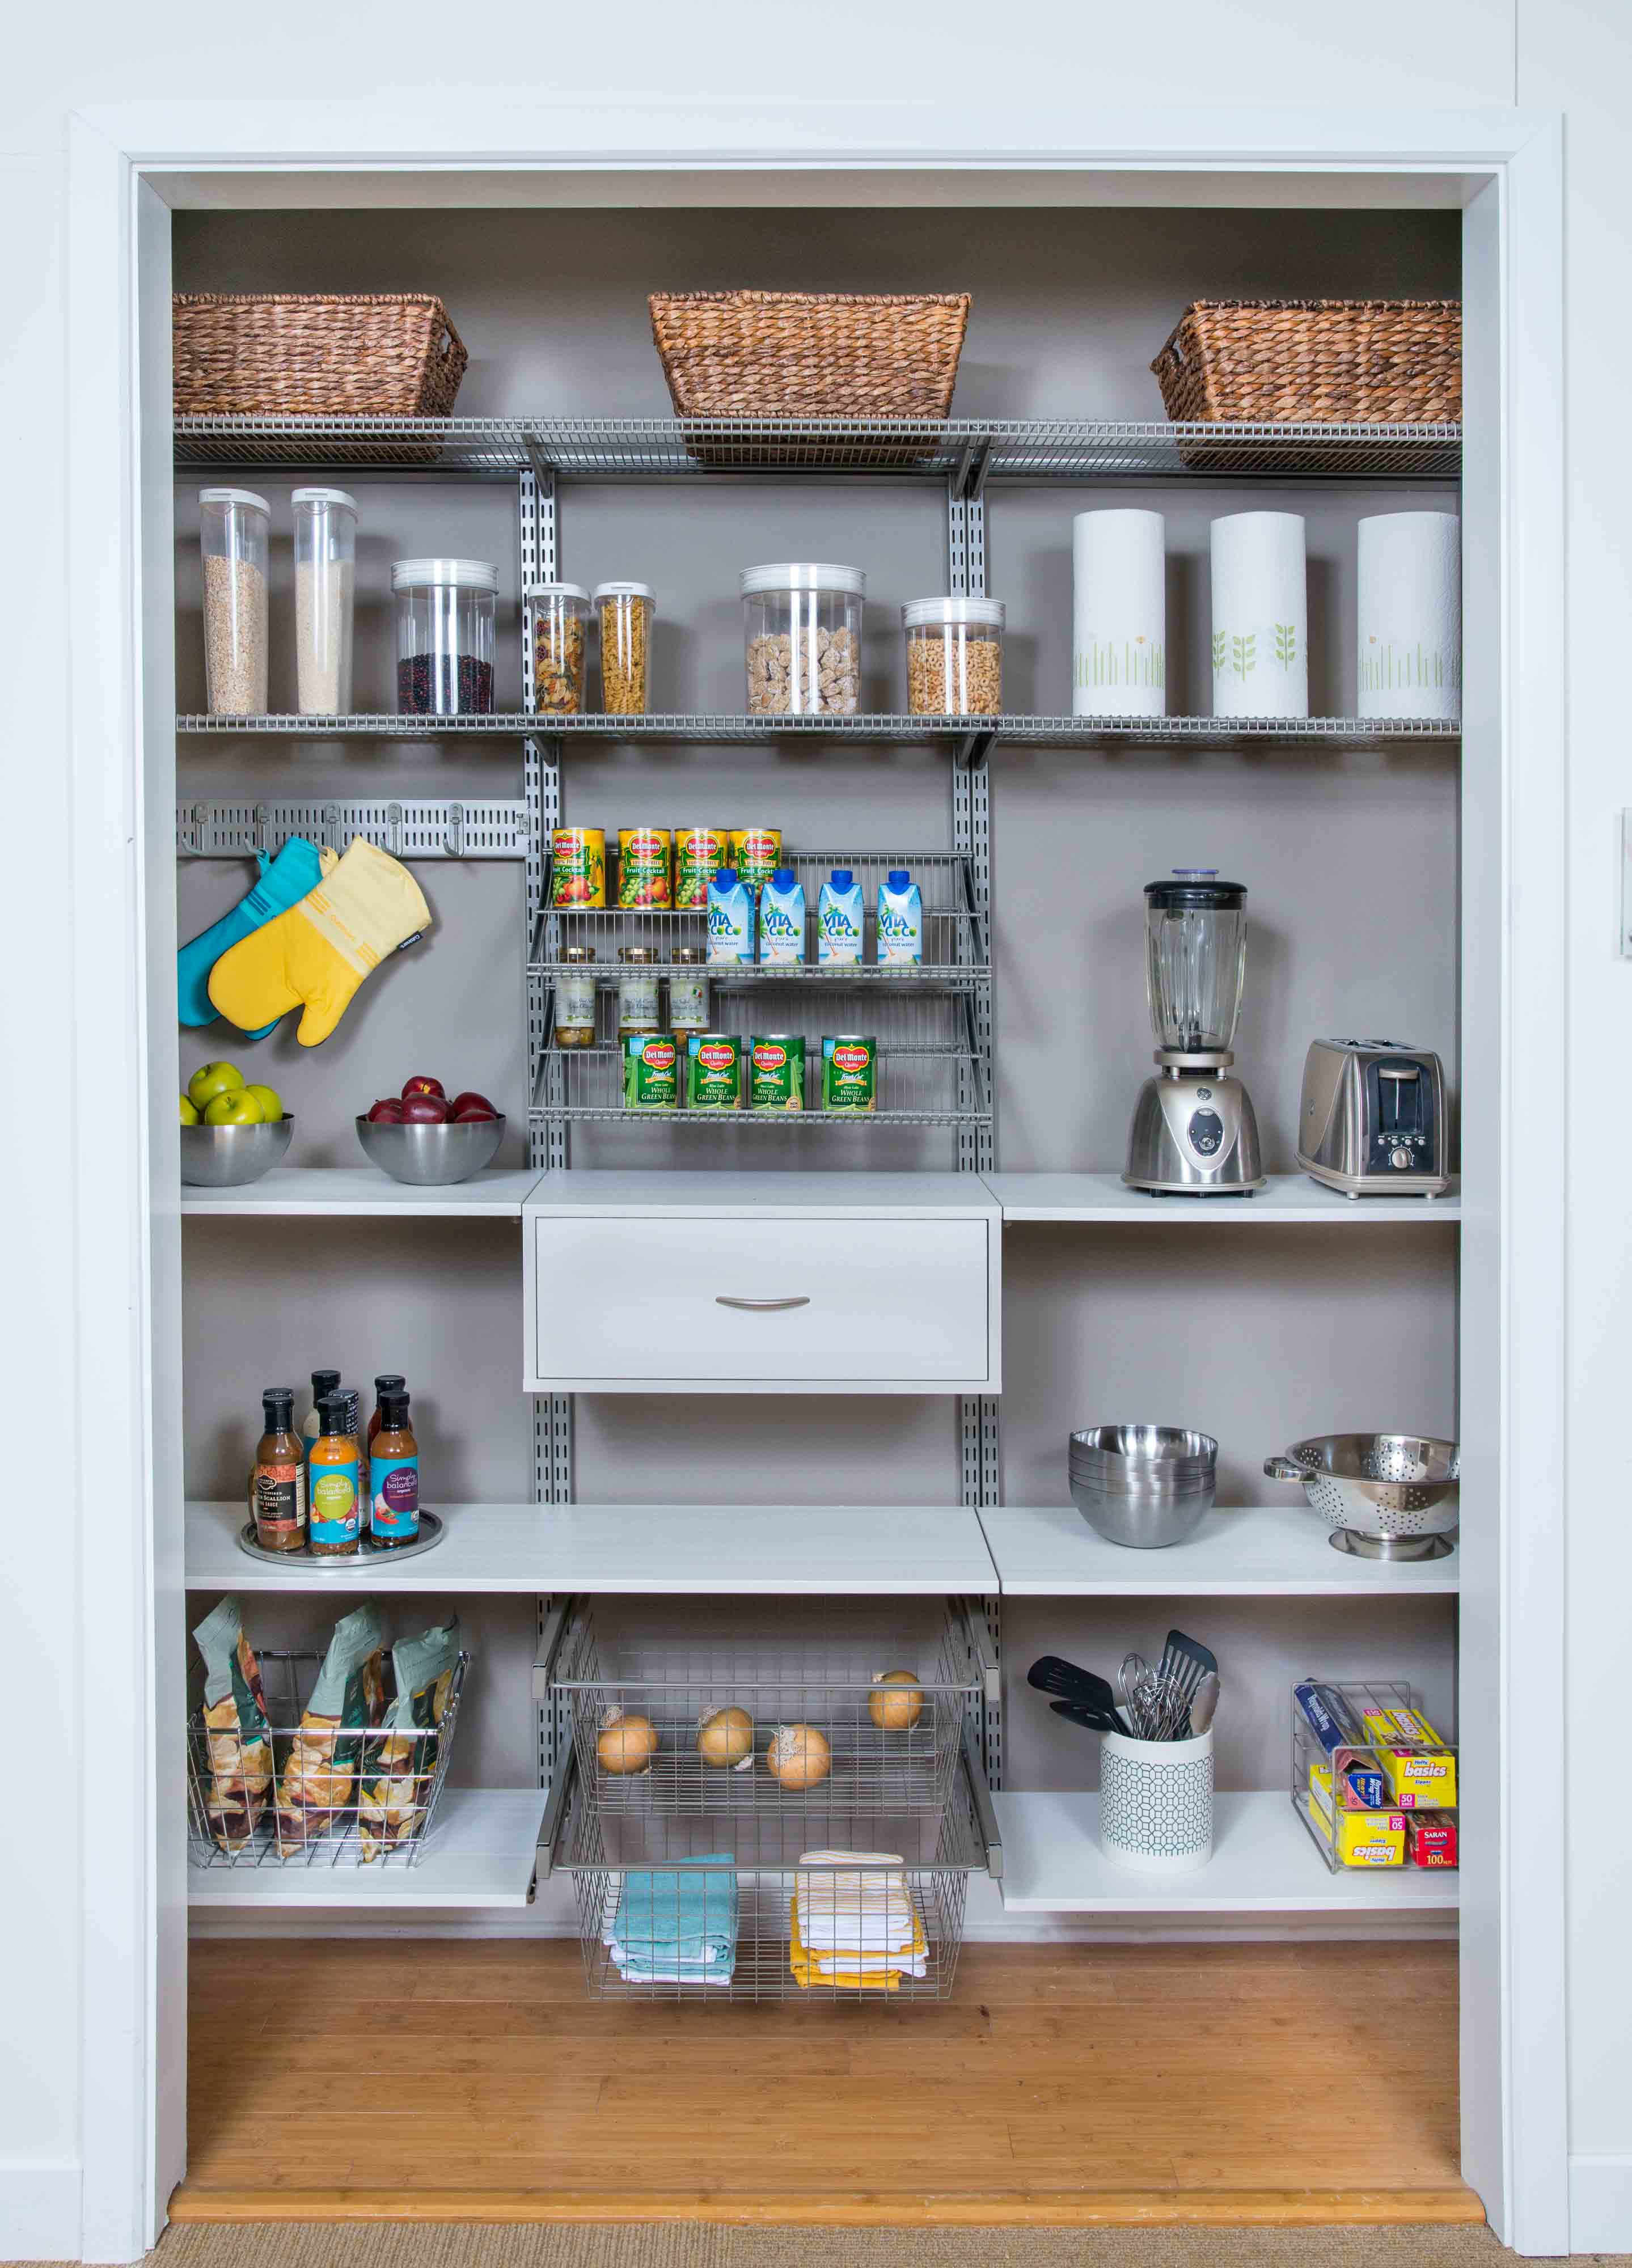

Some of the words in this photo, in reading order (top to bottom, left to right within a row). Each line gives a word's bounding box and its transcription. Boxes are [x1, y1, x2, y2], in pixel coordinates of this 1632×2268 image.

[764, 911, 792, 926] VITA
[823, 912, 851, 927] VITA
[881, 913, 907, 928] VITA
[828, 926, 860, 937] COCO
[885, 926, 917, 937] COCO
[390, 1470, 416, 1482] Simply
[1404, 1761, 1447, 1777] basics
[1352, 1796, 1358, 1805] 50
[1352, 1846, 1396, 1861] basics
[1426, 1855, 1444, 1865] 100
